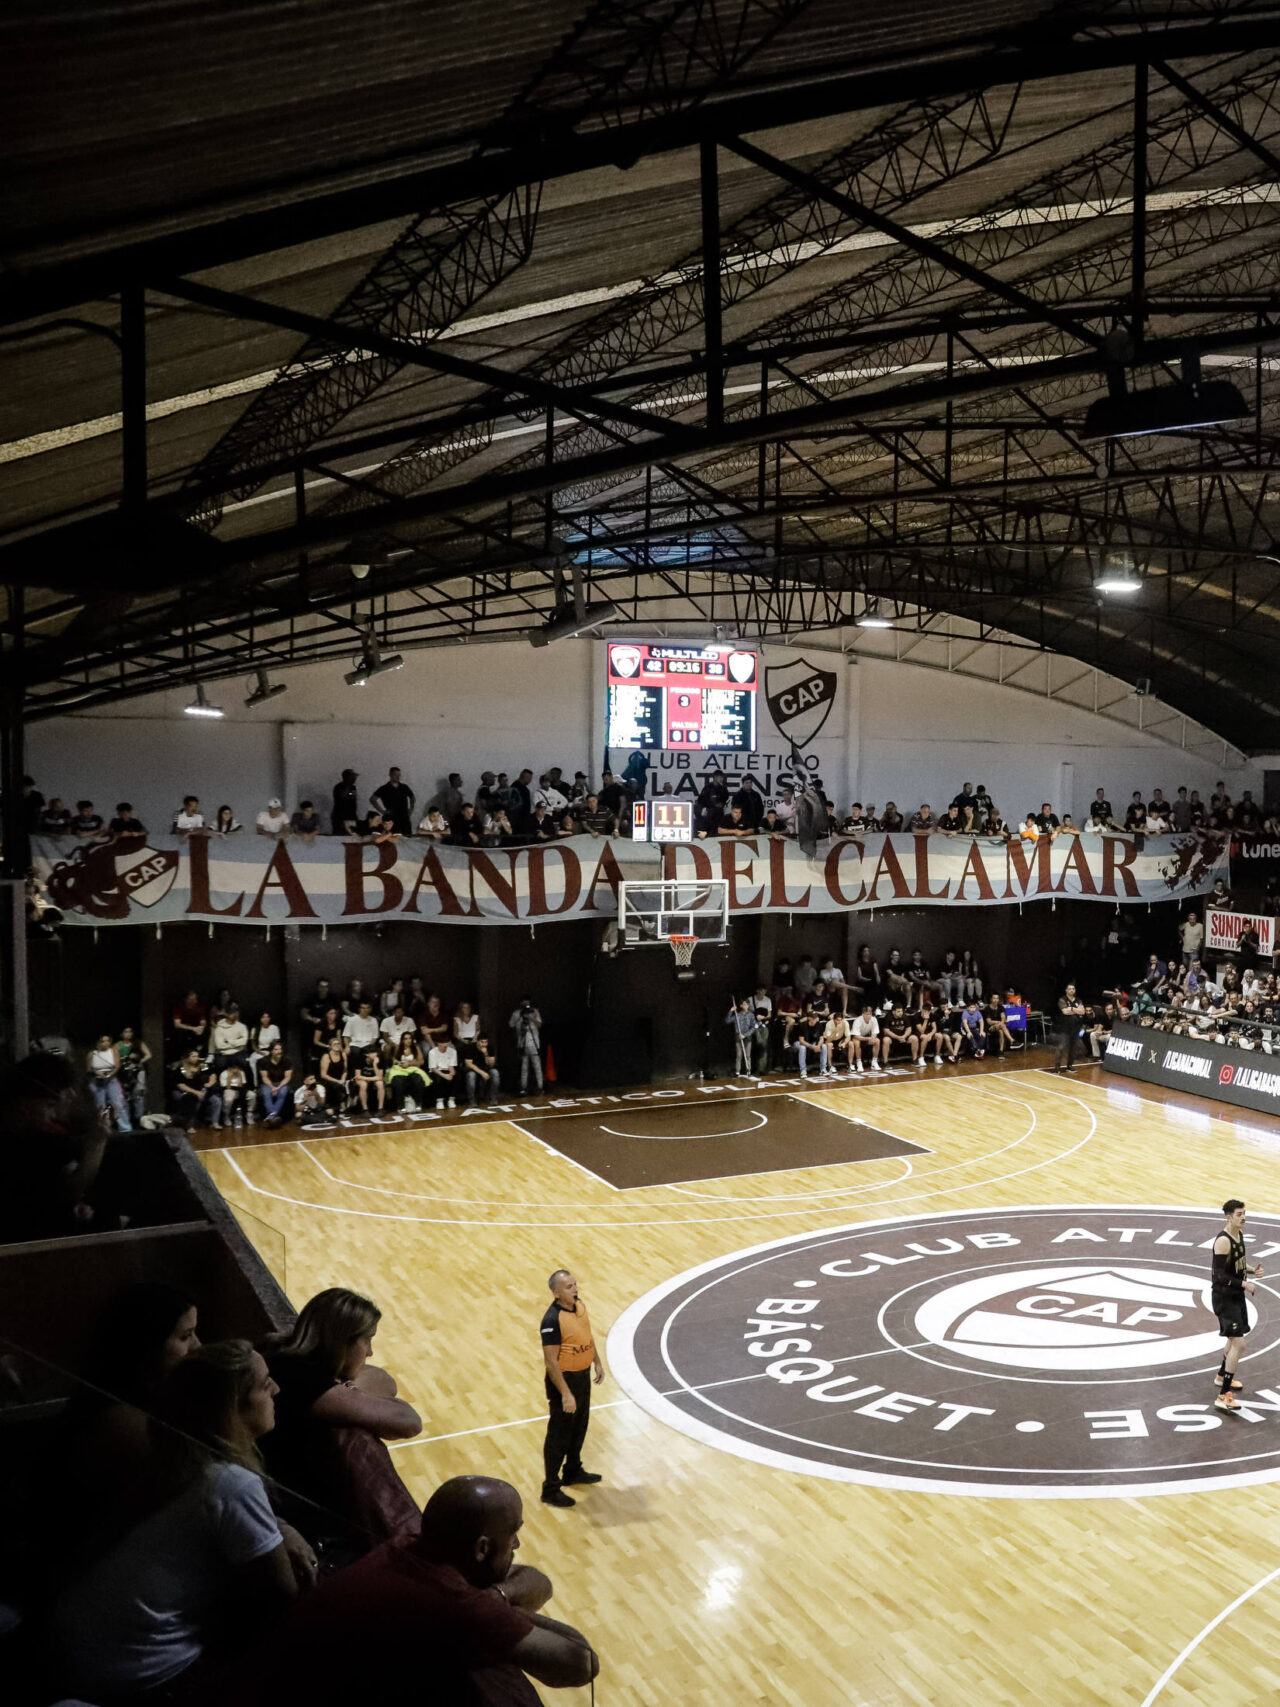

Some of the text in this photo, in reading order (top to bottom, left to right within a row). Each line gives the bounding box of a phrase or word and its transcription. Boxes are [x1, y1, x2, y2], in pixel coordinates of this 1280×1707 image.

[669, 662, 700, 673] 09:16
[779, 679, 824, 715] CAP
[648, 752, 691, 769] LUB
[651, 772, 819, 797] LATENS
[657, 805, 685, 825] 11
[124, 855, 168, 890] CAP
[185, 832, 1142, 919] LA BANDA DEL CALAMAR
[301, 1067, 916, 1132] CLUB ATLÉTICO PLATENSE
[819, 1232, 1022, 1277] CLUB
[1015, 1294, 1184, 1326] CAP
[743, 1298, 997, 1432] BÁSQUET
